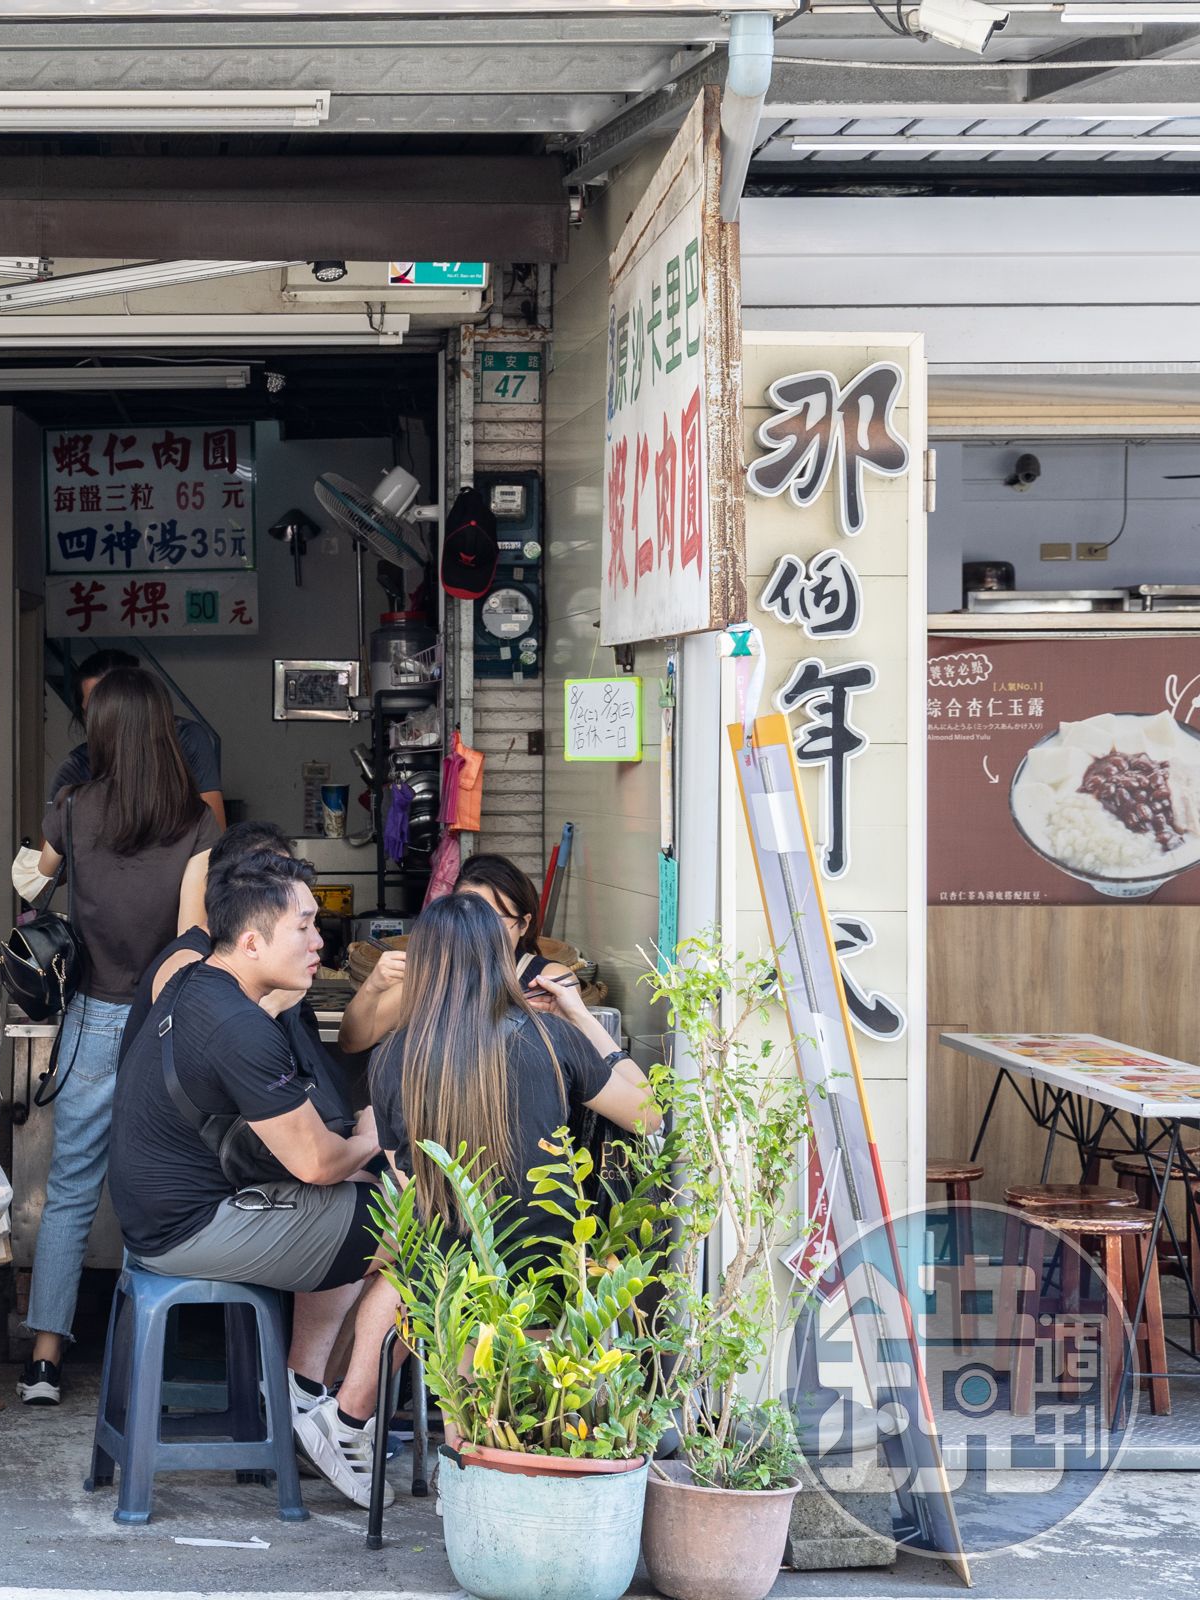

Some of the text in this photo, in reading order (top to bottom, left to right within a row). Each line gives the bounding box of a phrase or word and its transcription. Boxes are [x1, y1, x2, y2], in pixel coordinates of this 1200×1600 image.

[613, 236, 702, 410] 原沙卡里巴
[484, 354, 540, 368] 保安路
[494, 375, 527, 398] 47
[52, 428, 238, 477] 蝦仁肉圓
[53, 481, 246, 513] 每盤三粒 65 元
[607, 384, 703, 600] 蝦仁肉圓
[927, 697, 1045, 718] 綜合杏仁玉露
[573, 722, 627, 750] 店休二日
